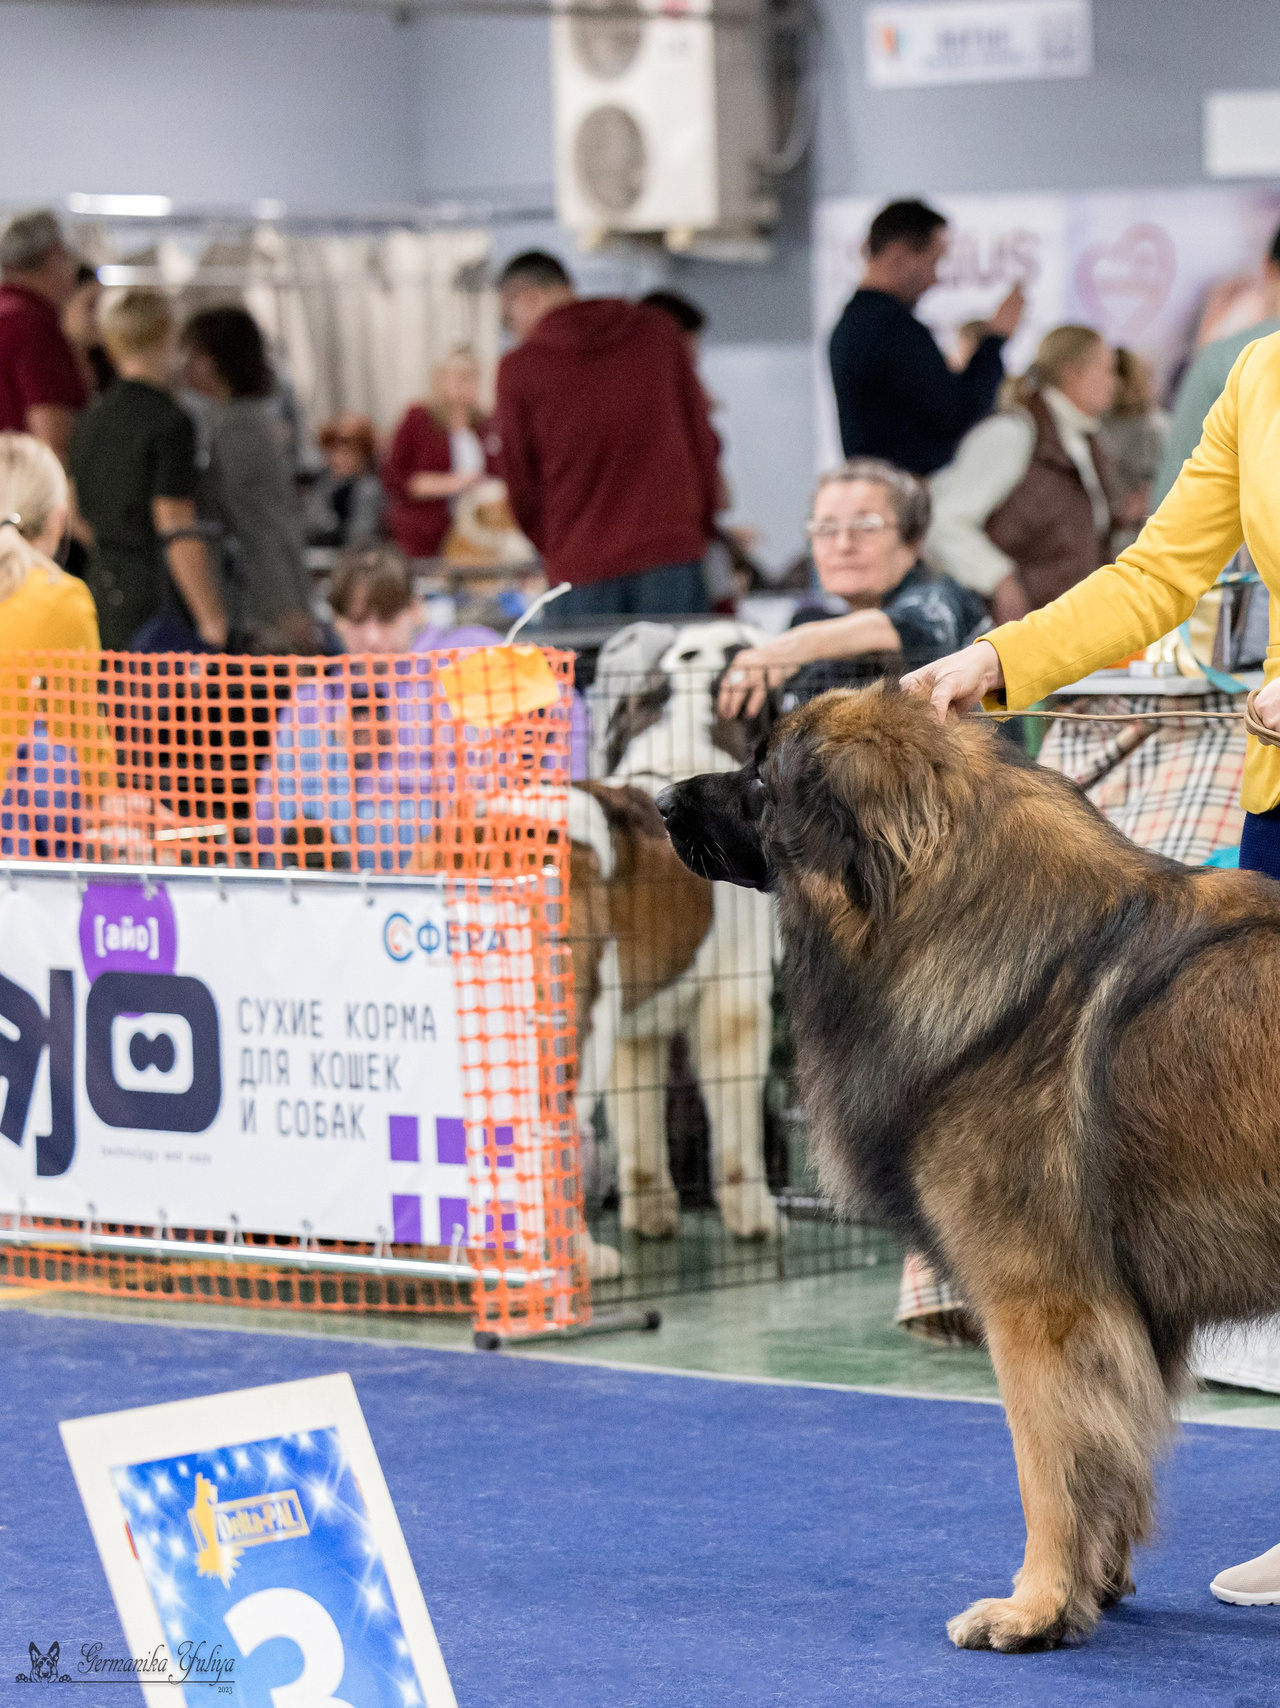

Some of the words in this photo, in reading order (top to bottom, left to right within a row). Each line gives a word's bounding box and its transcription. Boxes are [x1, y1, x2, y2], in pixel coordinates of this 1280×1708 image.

[237, 996, 324, 1039] СУХИЕ
[346, 1001, 437, 1042] КОРМА
[240, 1047, 290, 1091] ДЛЯ
[312, 1051, 402, 1092] КОШЕК
[241, 1098, 257, 1135] И
[276, 1098, 366, 1141] СОБАК
